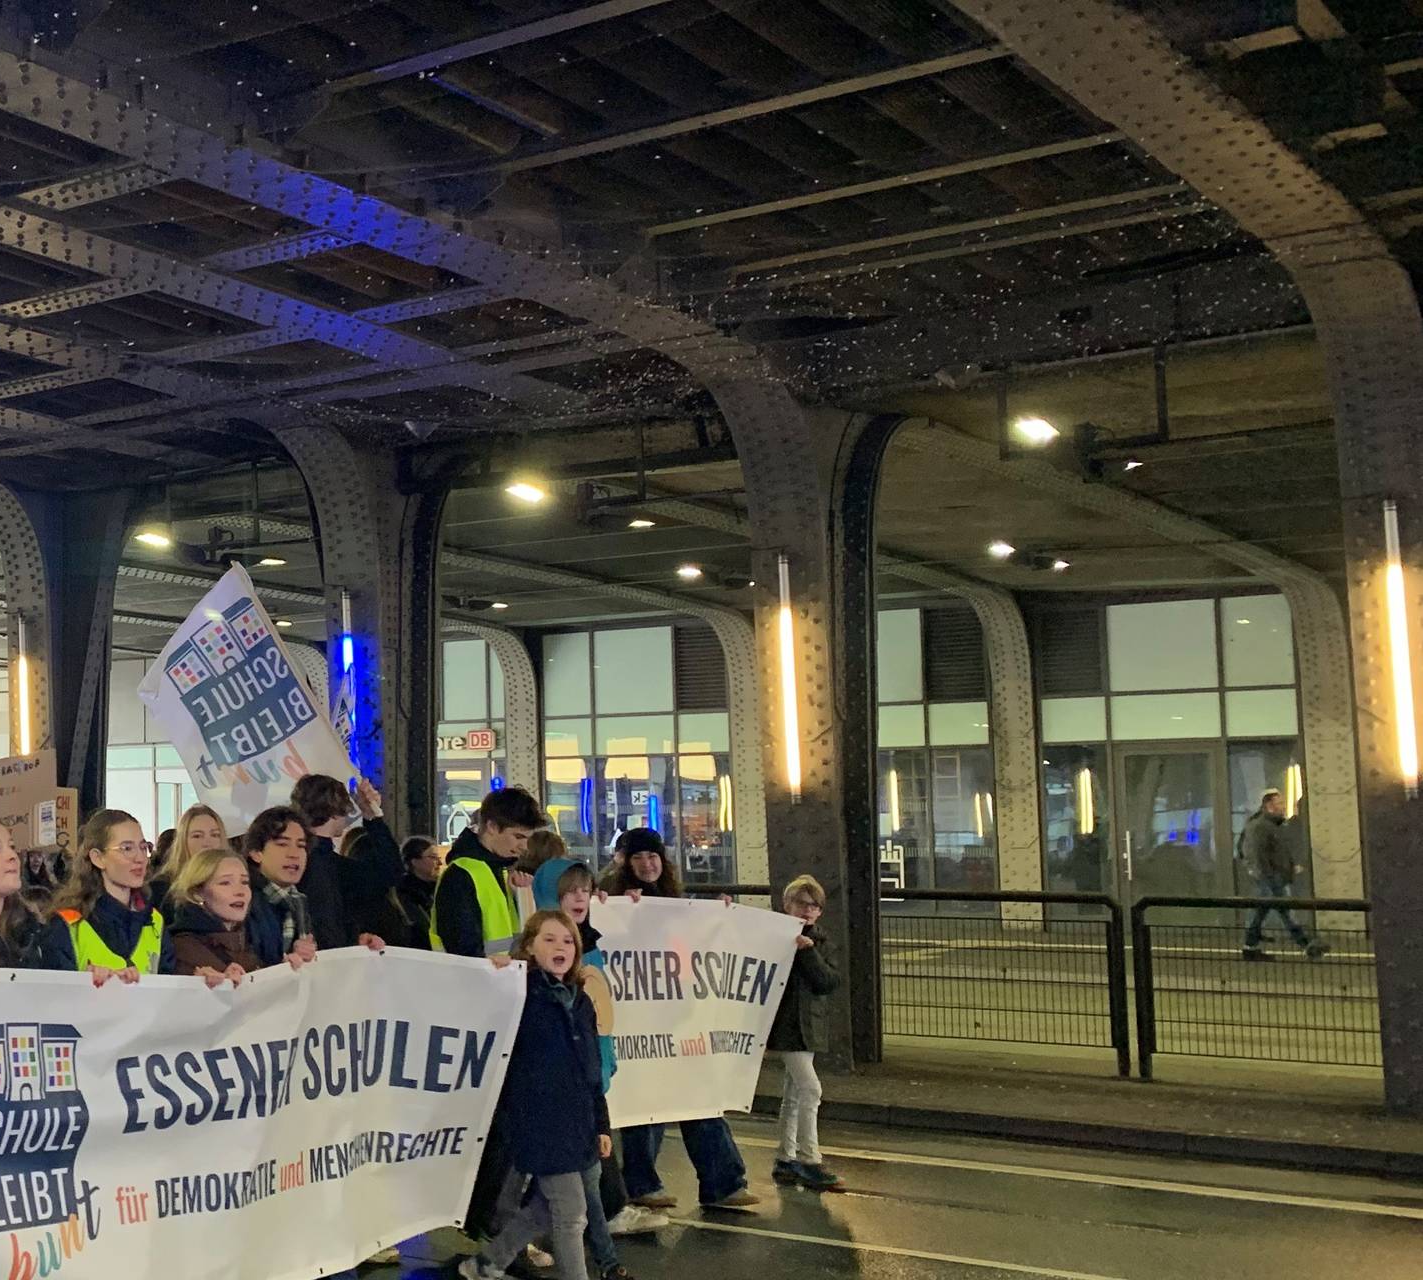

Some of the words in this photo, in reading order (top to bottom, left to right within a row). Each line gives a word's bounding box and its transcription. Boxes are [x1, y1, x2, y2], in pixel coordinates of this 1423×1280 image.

[602, 949, 684, 1001] SSENER
[302, 1019, 496, 1101] SCHULEN
[613, 1033, 677, 1060] EMOKRATIE
[681, 1032, 706, 1056] und
[115, 1186, 149, 1225] für
[154, 1159, 277, 1219] DEMOKRATIE
[280, 1151, 305, 1192] und
